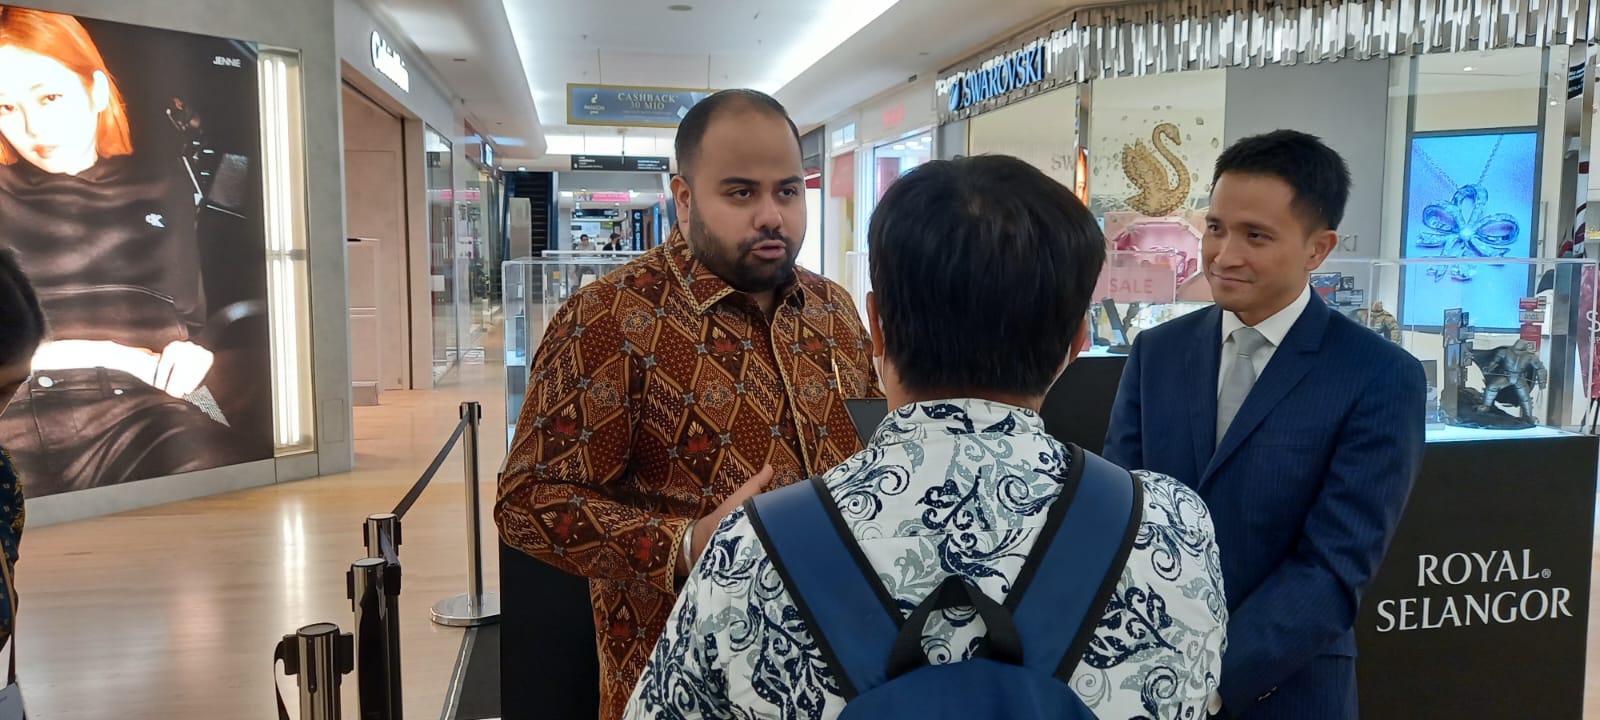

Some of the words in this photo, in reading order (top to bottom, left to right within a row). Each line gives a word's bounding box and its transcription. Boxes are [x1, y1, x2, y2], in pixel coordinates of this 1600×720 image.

[212, 55, 242, 69] JENNIE
[963, 46, 1045, 107] SWAROVSKI
[617, 92, 676, 104] CASHBACK
[644, 101, 666, 111] MIO
[1108, 278, 1154, 294] SALE
[1375, 586, 1574, 633] SELANGOR
